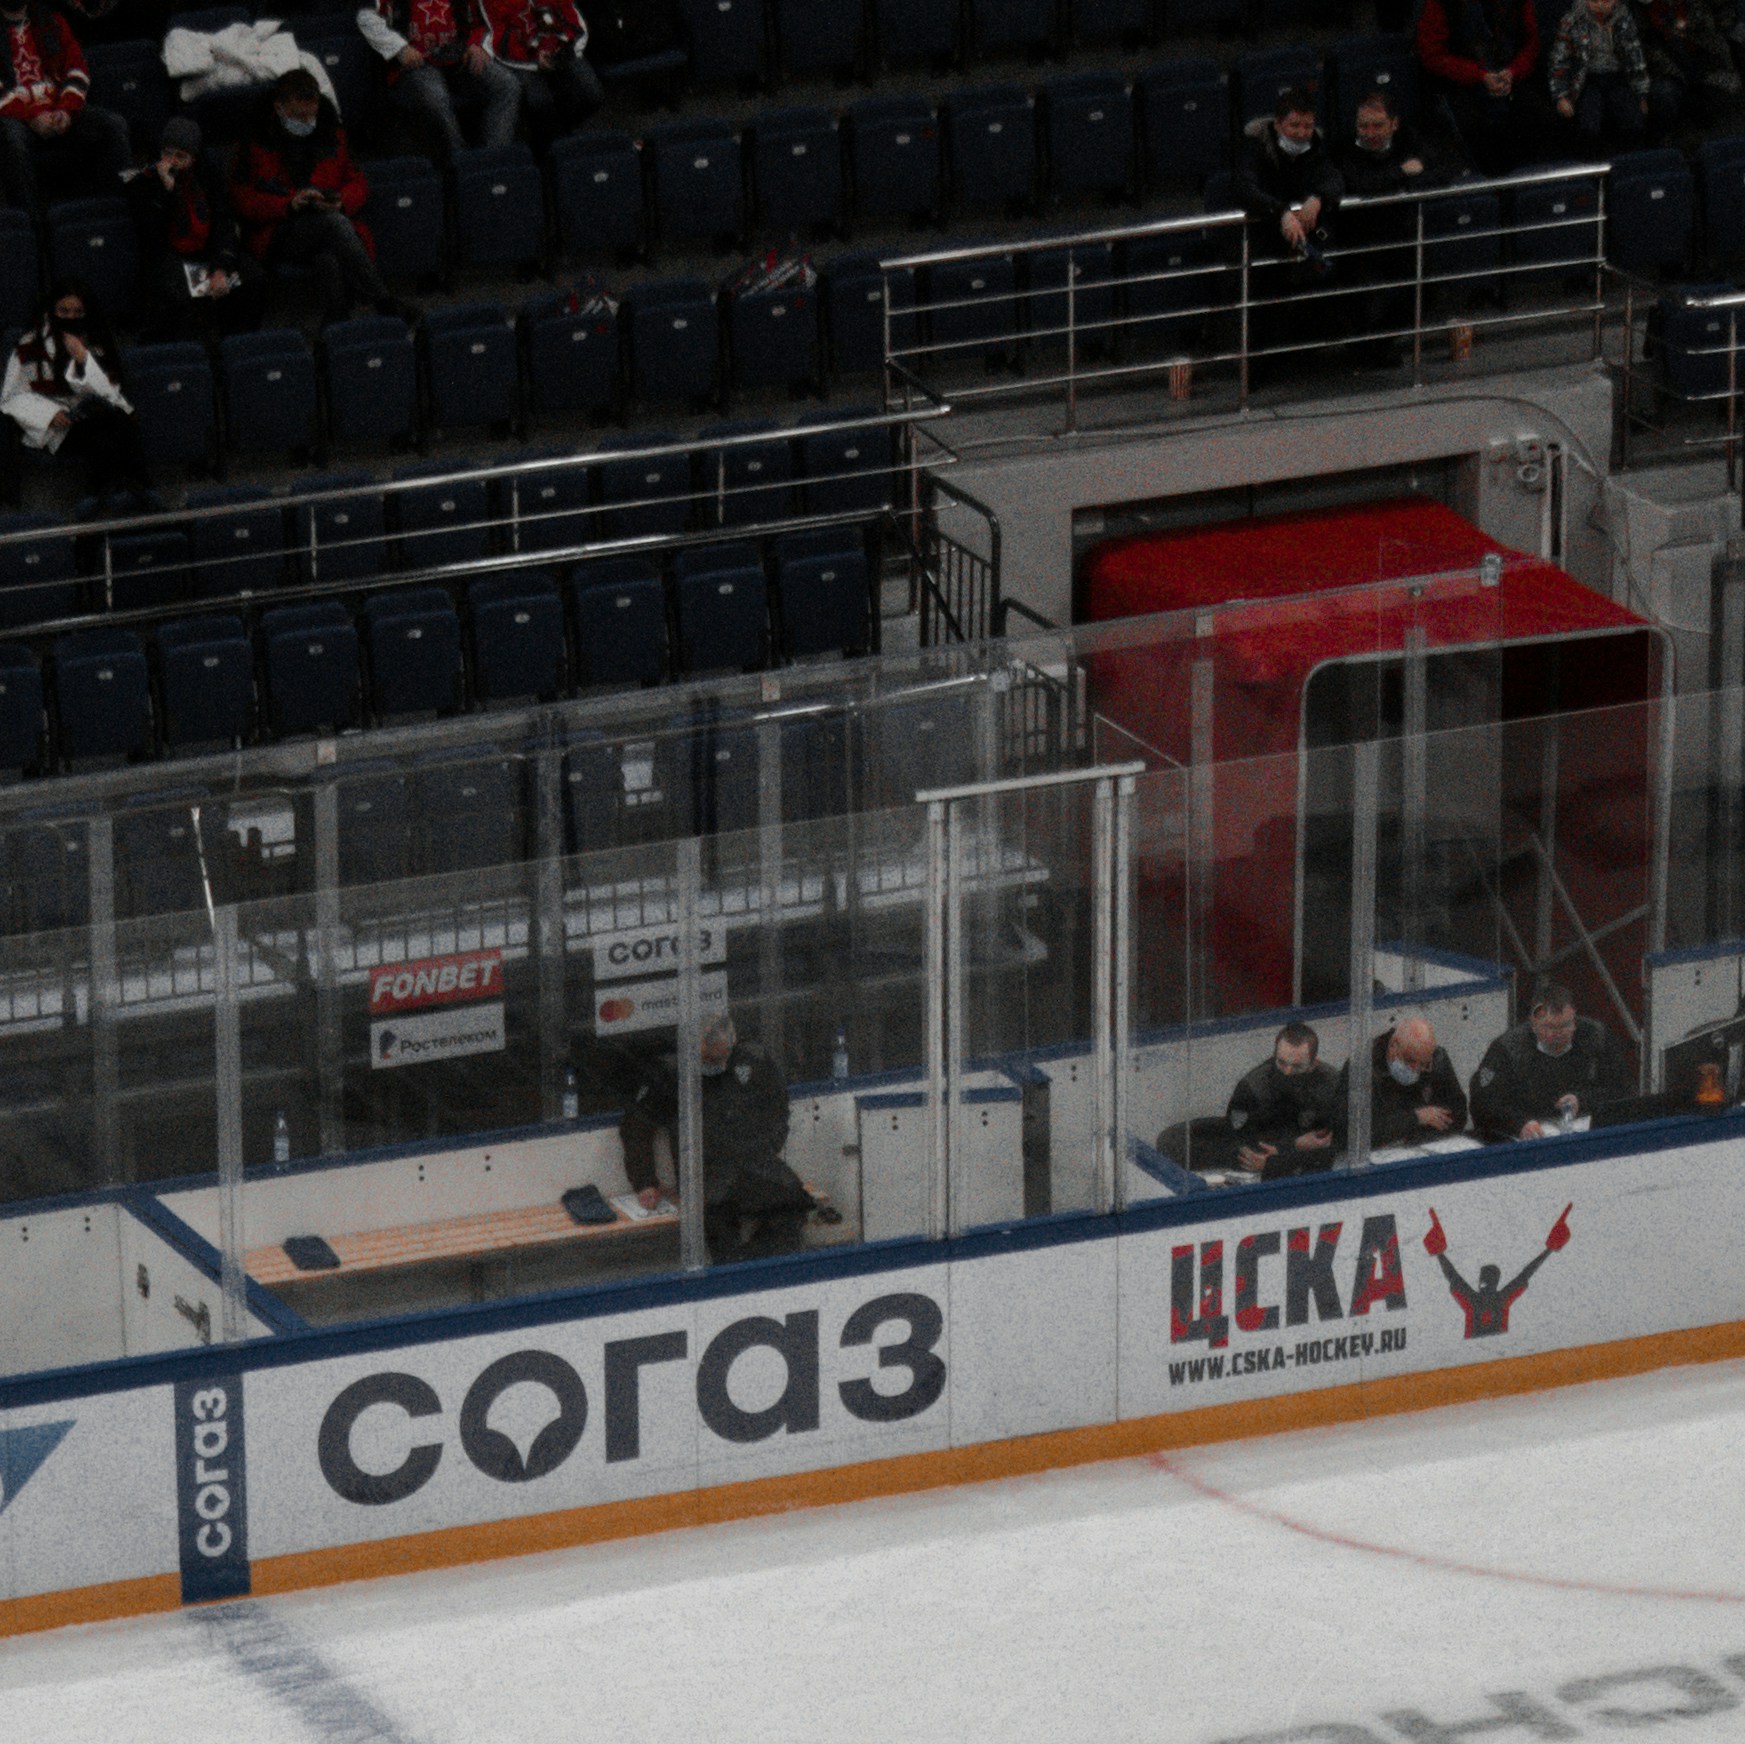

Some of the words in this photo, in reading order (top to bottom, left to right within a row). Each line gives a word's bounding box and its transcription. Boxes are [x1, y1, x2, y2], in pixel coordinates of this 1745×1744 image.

[372, 957, 500, 1003] FONBET
[400, 1029, 497, 1054] Ростелеком
[1170, 1214, 1407, 1349] ЦСКА
[1169, 1327, 1407, 1386] WWW.CSKA-HOCKEY.RU
